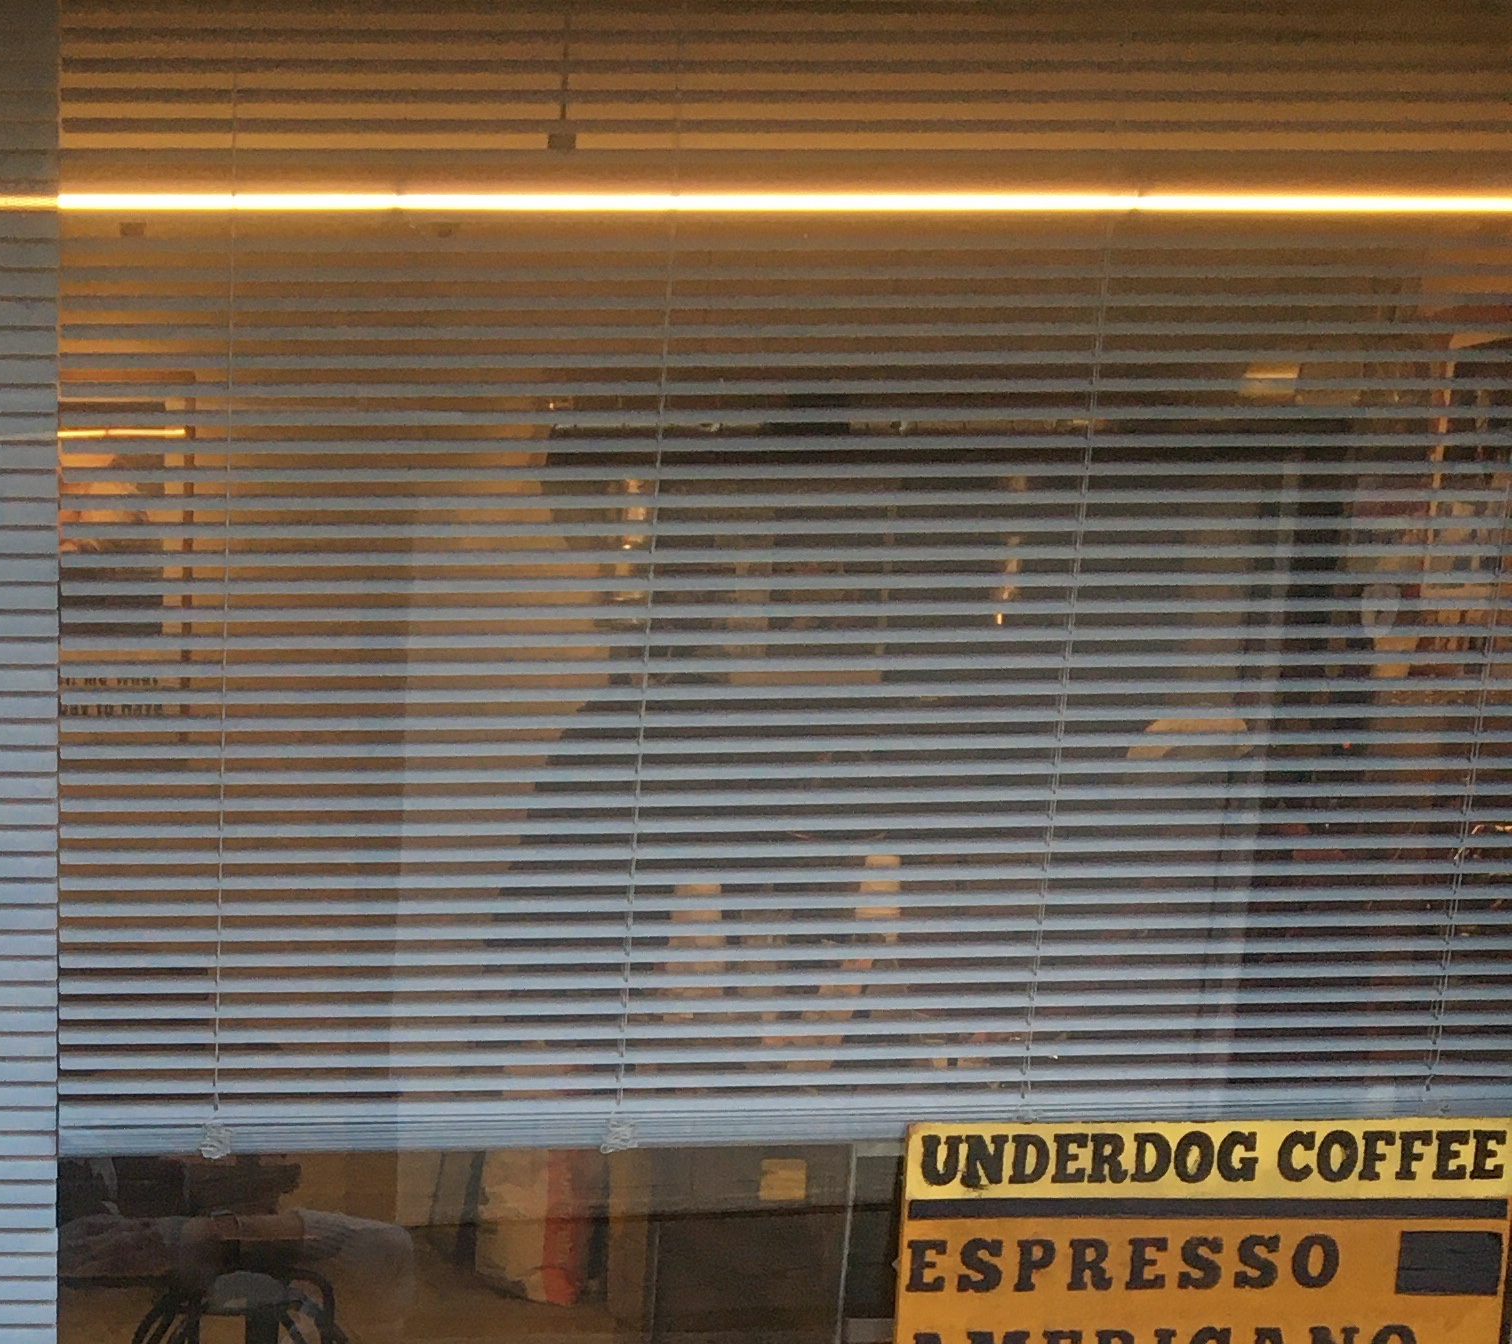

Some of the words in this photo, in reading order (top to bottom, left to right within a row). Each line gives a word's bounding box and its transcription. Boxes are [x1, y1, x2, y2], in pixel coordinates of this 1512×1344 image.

[920, 1131, 1259, 1187] UNDERDOG
[1277, 1129, 1507, 1183] COFFEE
[905, 1233, 1340, 1293] ESPRESSO
